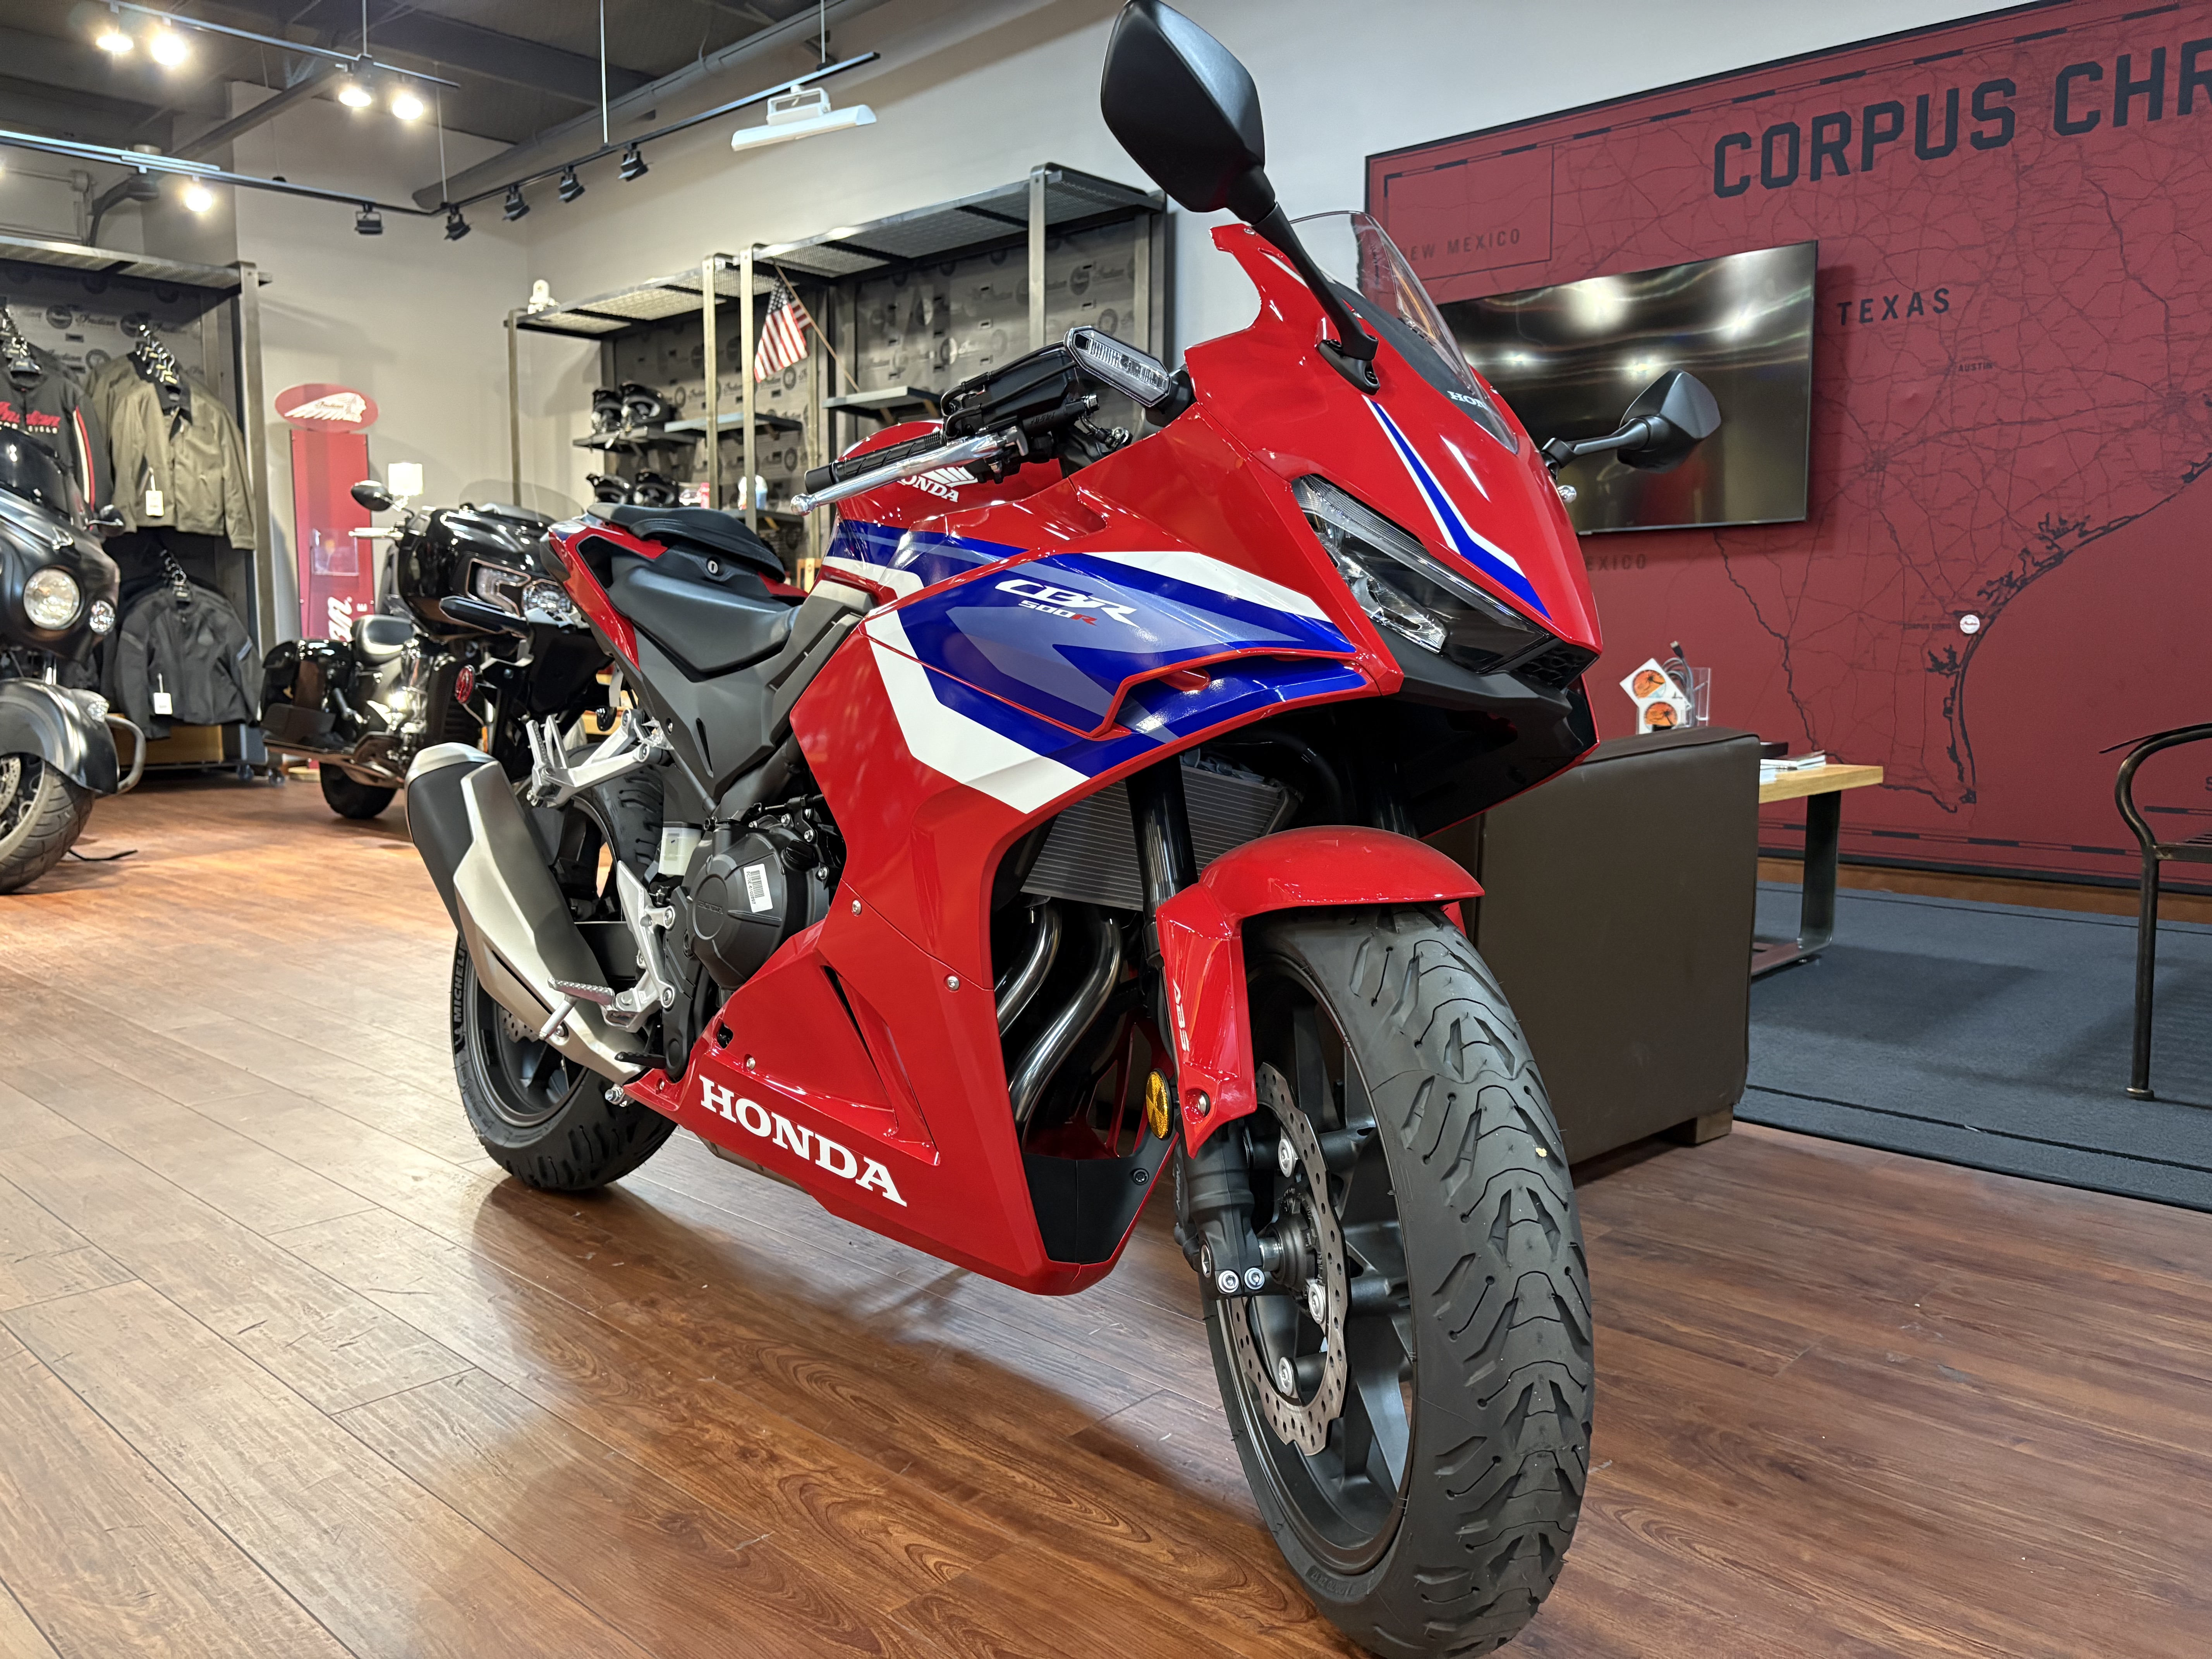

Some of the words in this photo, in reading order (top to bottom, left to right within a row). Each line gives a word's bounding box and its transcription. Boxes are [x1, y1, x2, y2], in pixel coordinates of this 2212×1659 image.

[1713, 78, 2016, 198] CORPUS
[2053, 37, 2212, 136] CHR
[1447, 228, 1520, 255] MEXICO
[1838, 288, 1950, 325] TEXAS
[1958, 362, 1993, 372] AUSTIN
[1447, 390, 1489, 411] HON
[898, 471, 959, 503] ONDA
[1585, 554, 1646, 571] EXICO
[995, 579, 1140, 628] CBR
[1018, 599, 1097, 626] 500R
[1172, 977, 1190, 1053] ABS
[699, 1074, 907, 1207] HONDA
